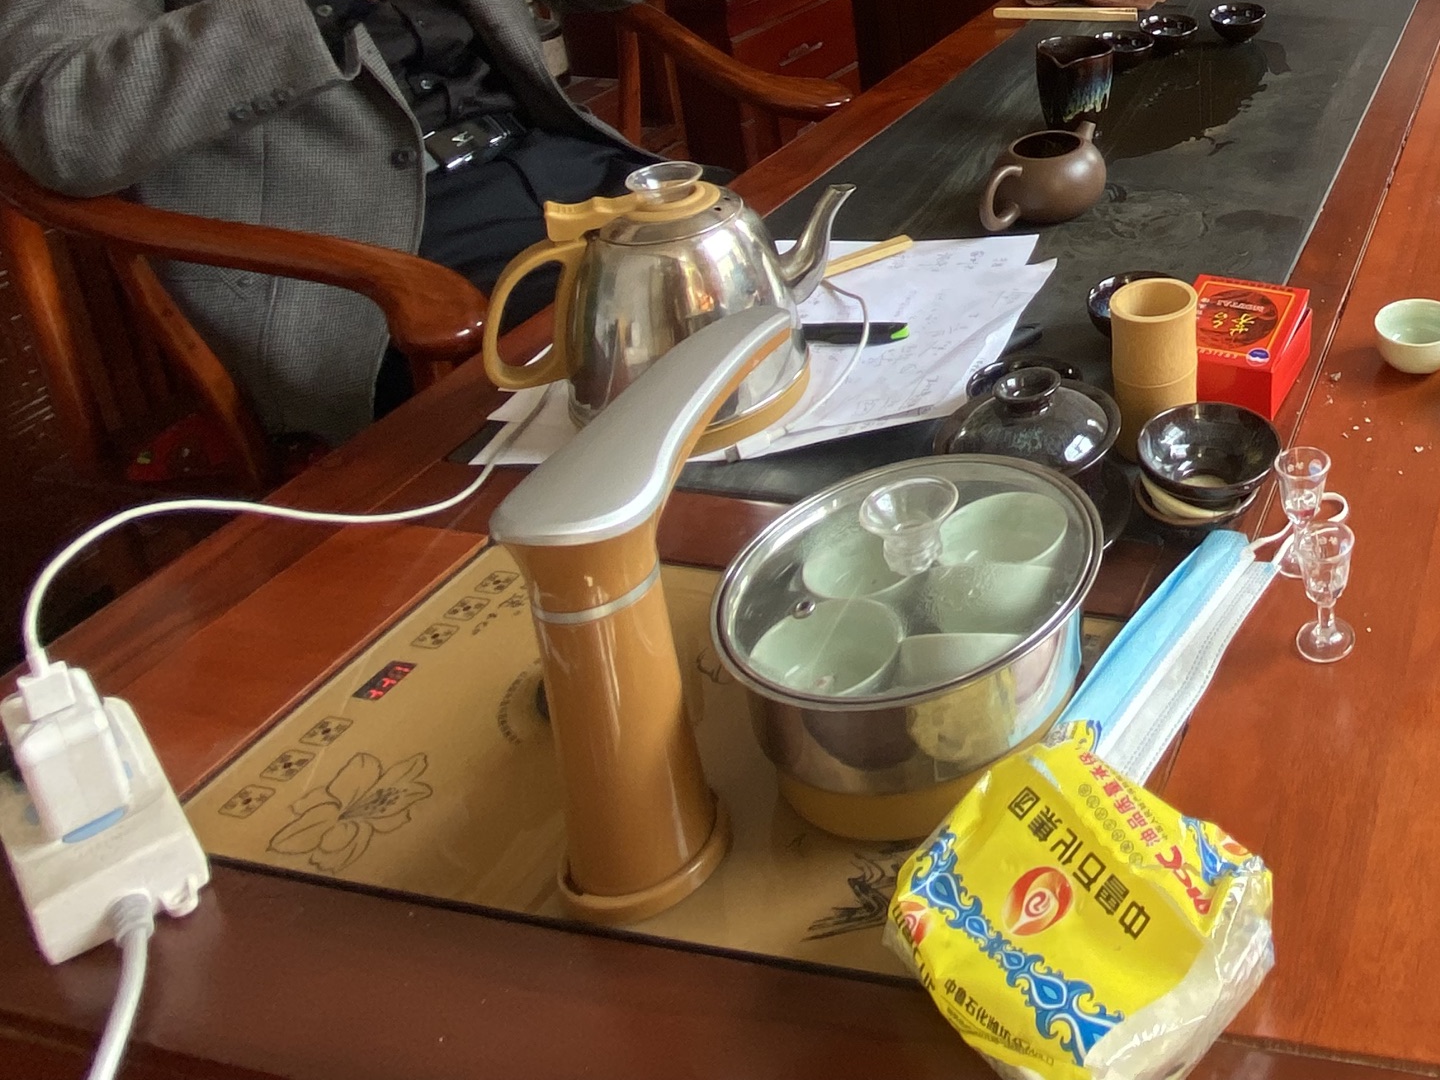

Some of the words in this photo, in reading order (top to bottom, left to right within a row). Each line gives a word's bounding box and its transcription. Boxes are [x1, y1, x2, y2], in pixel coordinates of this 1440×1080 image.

[1213, 311, 1256, 336] 茅台
[1078, 751, 1162, 848] 油品质量承保
[1007, 786, 1150, 940] 中鲁石化集团
